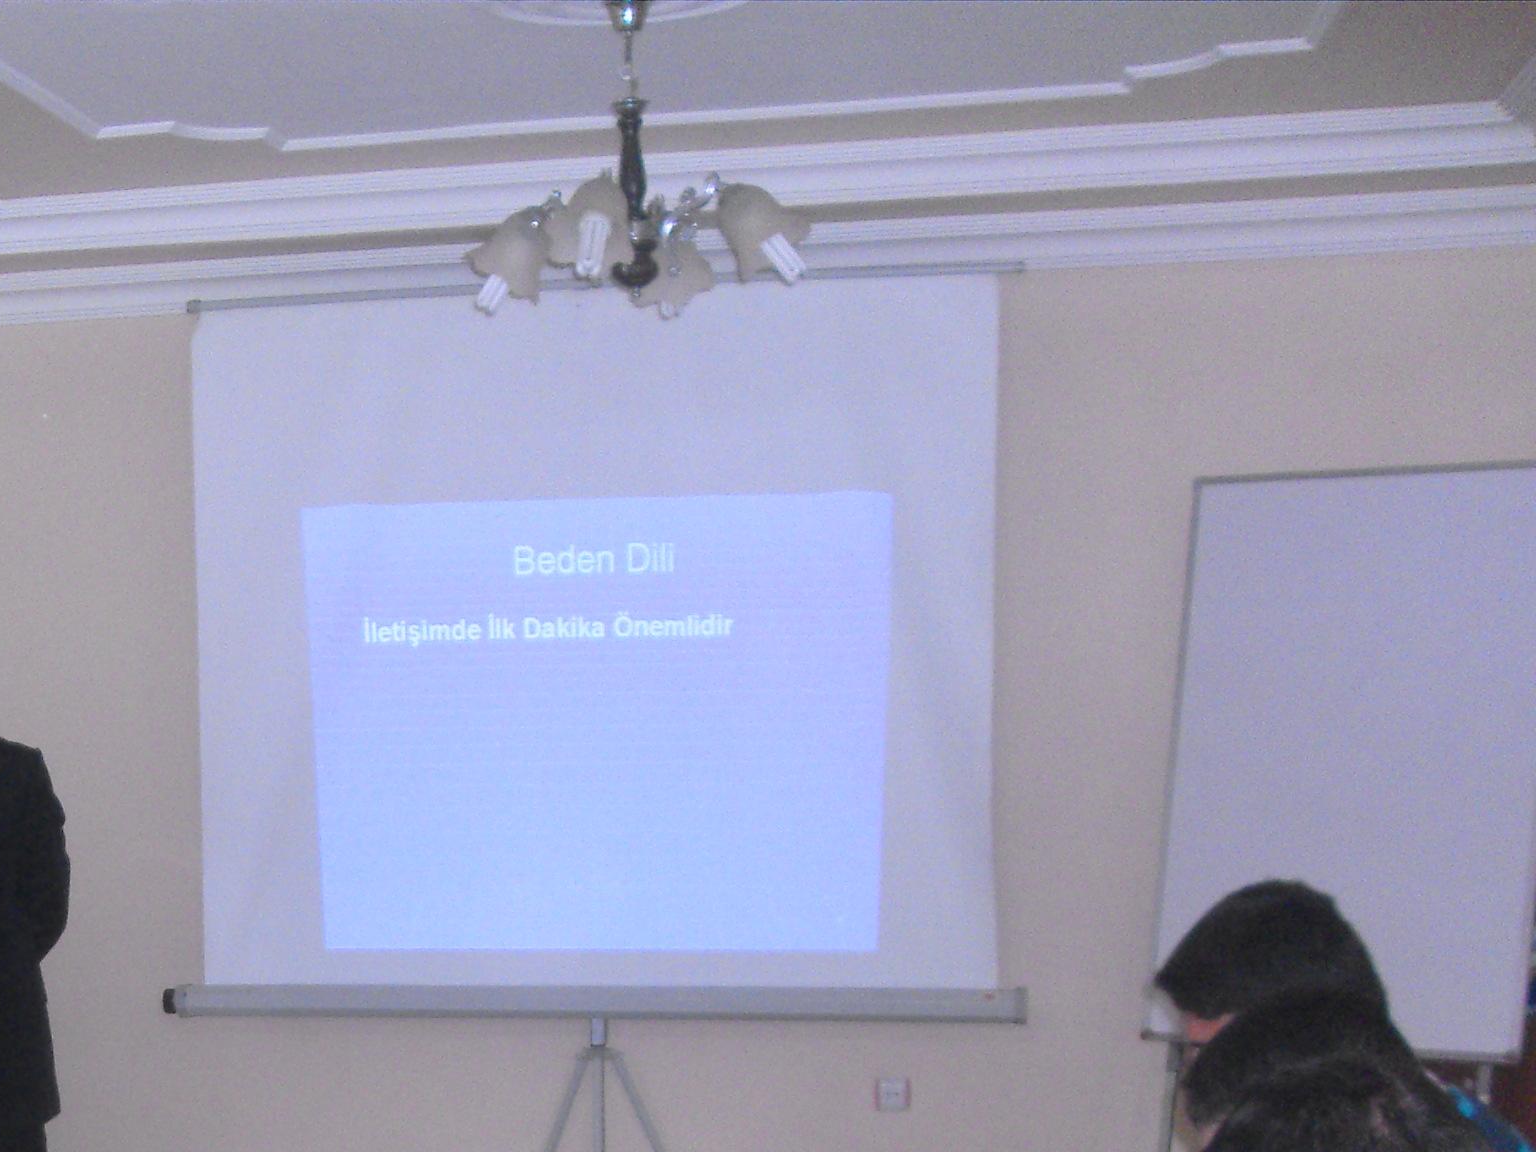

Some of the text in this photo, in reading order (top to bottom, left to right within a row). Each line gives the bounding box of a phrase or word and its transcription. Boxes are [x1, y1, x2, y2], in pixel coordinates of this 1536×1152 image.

[514, 542, 675, 576] Beden Dili
[363, 611, 734, 646] İletişimde İlk Dakika Önemlidir
